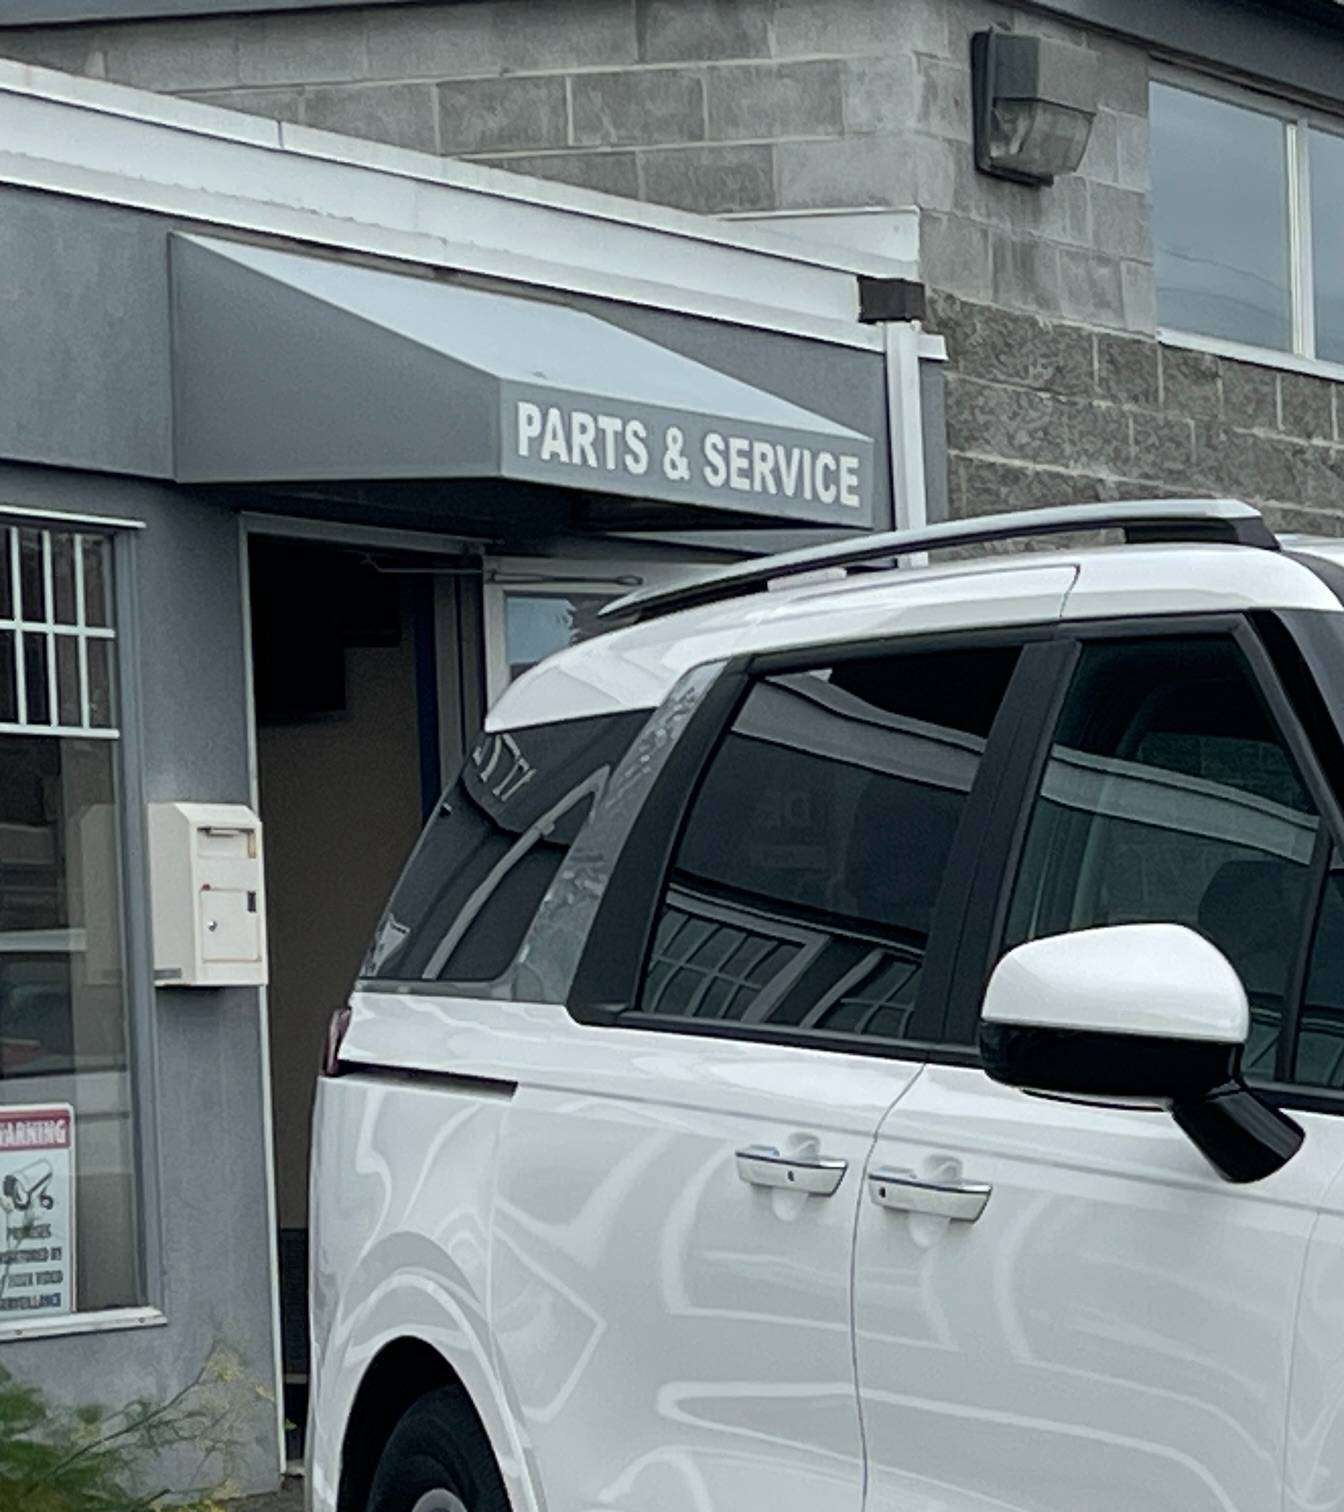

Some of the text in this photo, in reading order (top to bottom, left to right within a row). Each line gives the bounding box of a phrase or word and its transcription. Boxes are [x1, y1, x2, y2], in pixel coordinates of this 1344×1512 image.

[517, 401, 861, 508] PARTS & SERVICE
